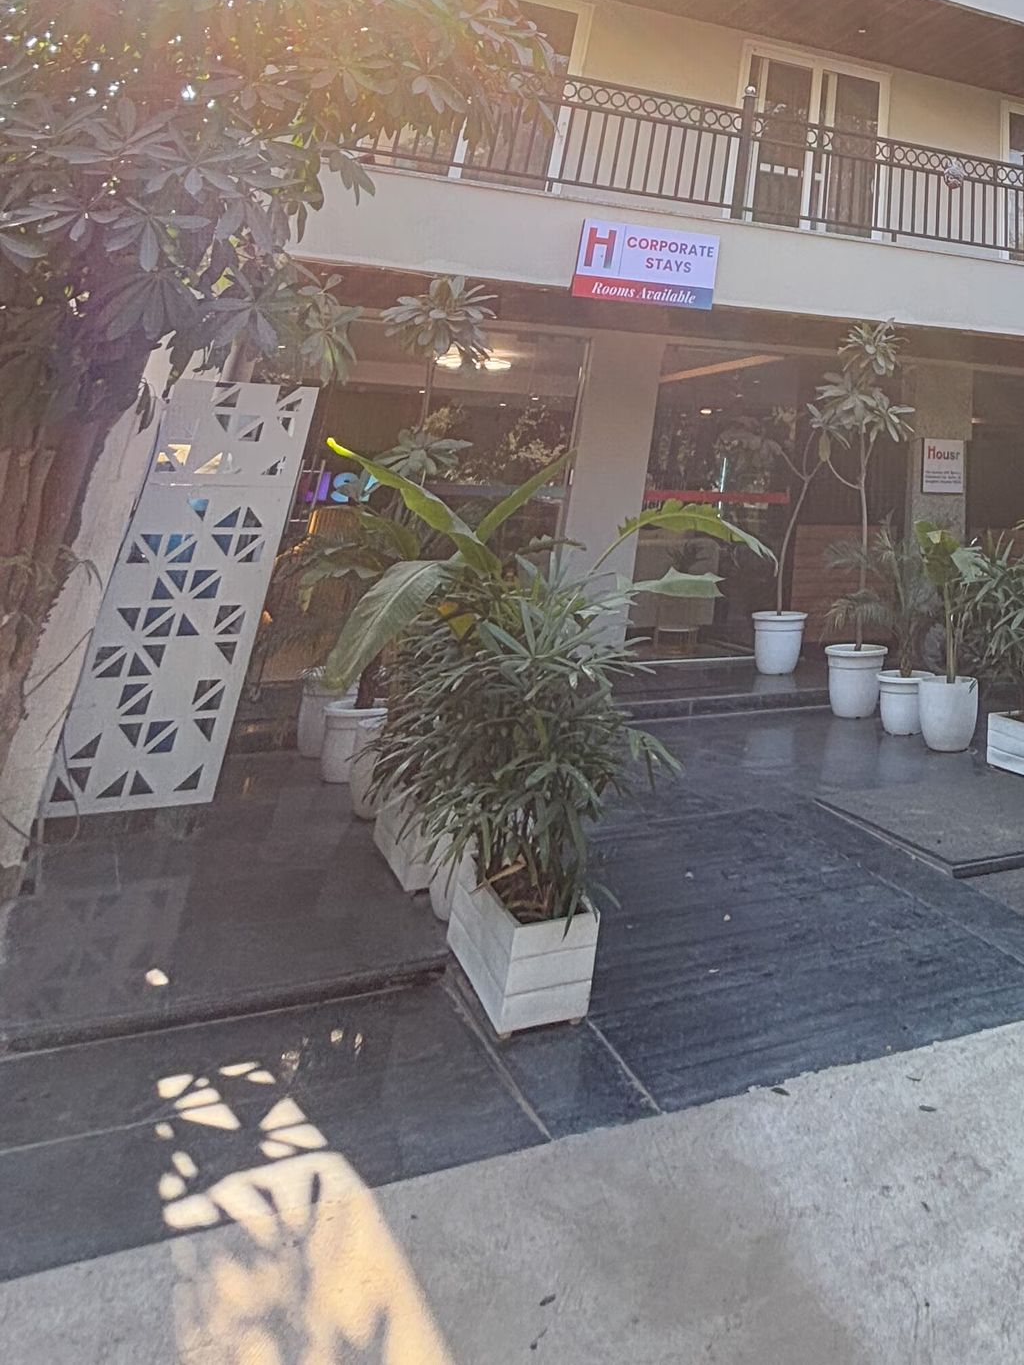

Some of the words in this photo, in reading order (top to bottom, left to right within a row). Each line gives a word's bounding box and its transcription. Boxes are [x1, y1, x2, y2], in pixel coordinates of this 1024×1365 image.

[583, 227, 617, 269] H
[627, 236, 714, 258] CORPORATE
[645, 257, 692, 273] STAYS
[591, 282, 634, 298] Rooms
[636, 288, 696, 304] Available
[927, 445, 961, 460] Housr
